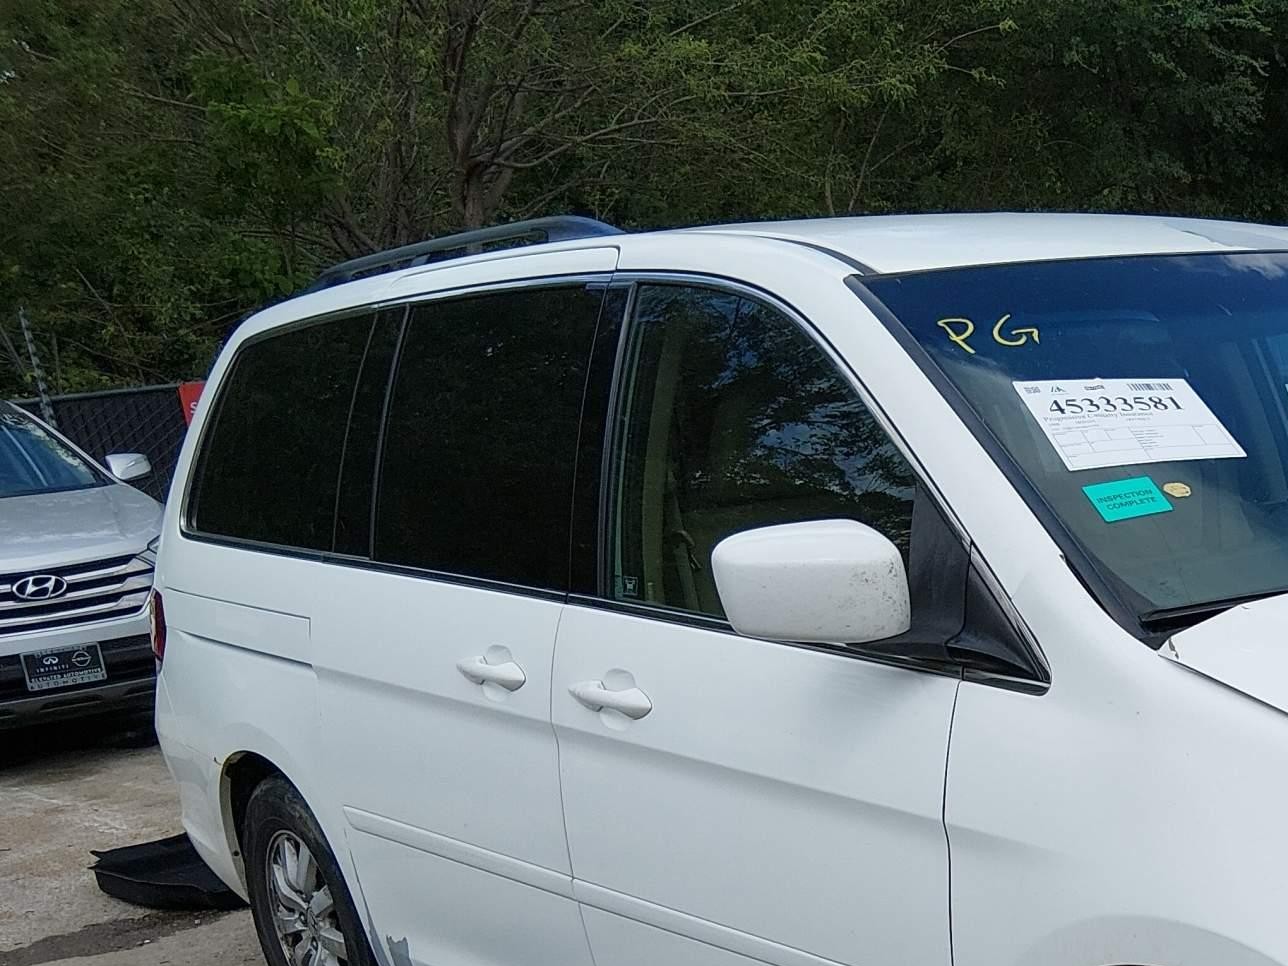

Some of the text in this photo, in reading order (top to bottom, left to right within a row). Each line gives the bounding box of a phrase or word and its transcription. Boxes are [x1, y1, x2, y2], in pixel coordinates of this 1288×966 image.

[1049, 396, 1183, 414] 45333581
[1096, 489, 1153, 503] INSPECTION
[1106, 497, 1157, 510] COMPLETE
